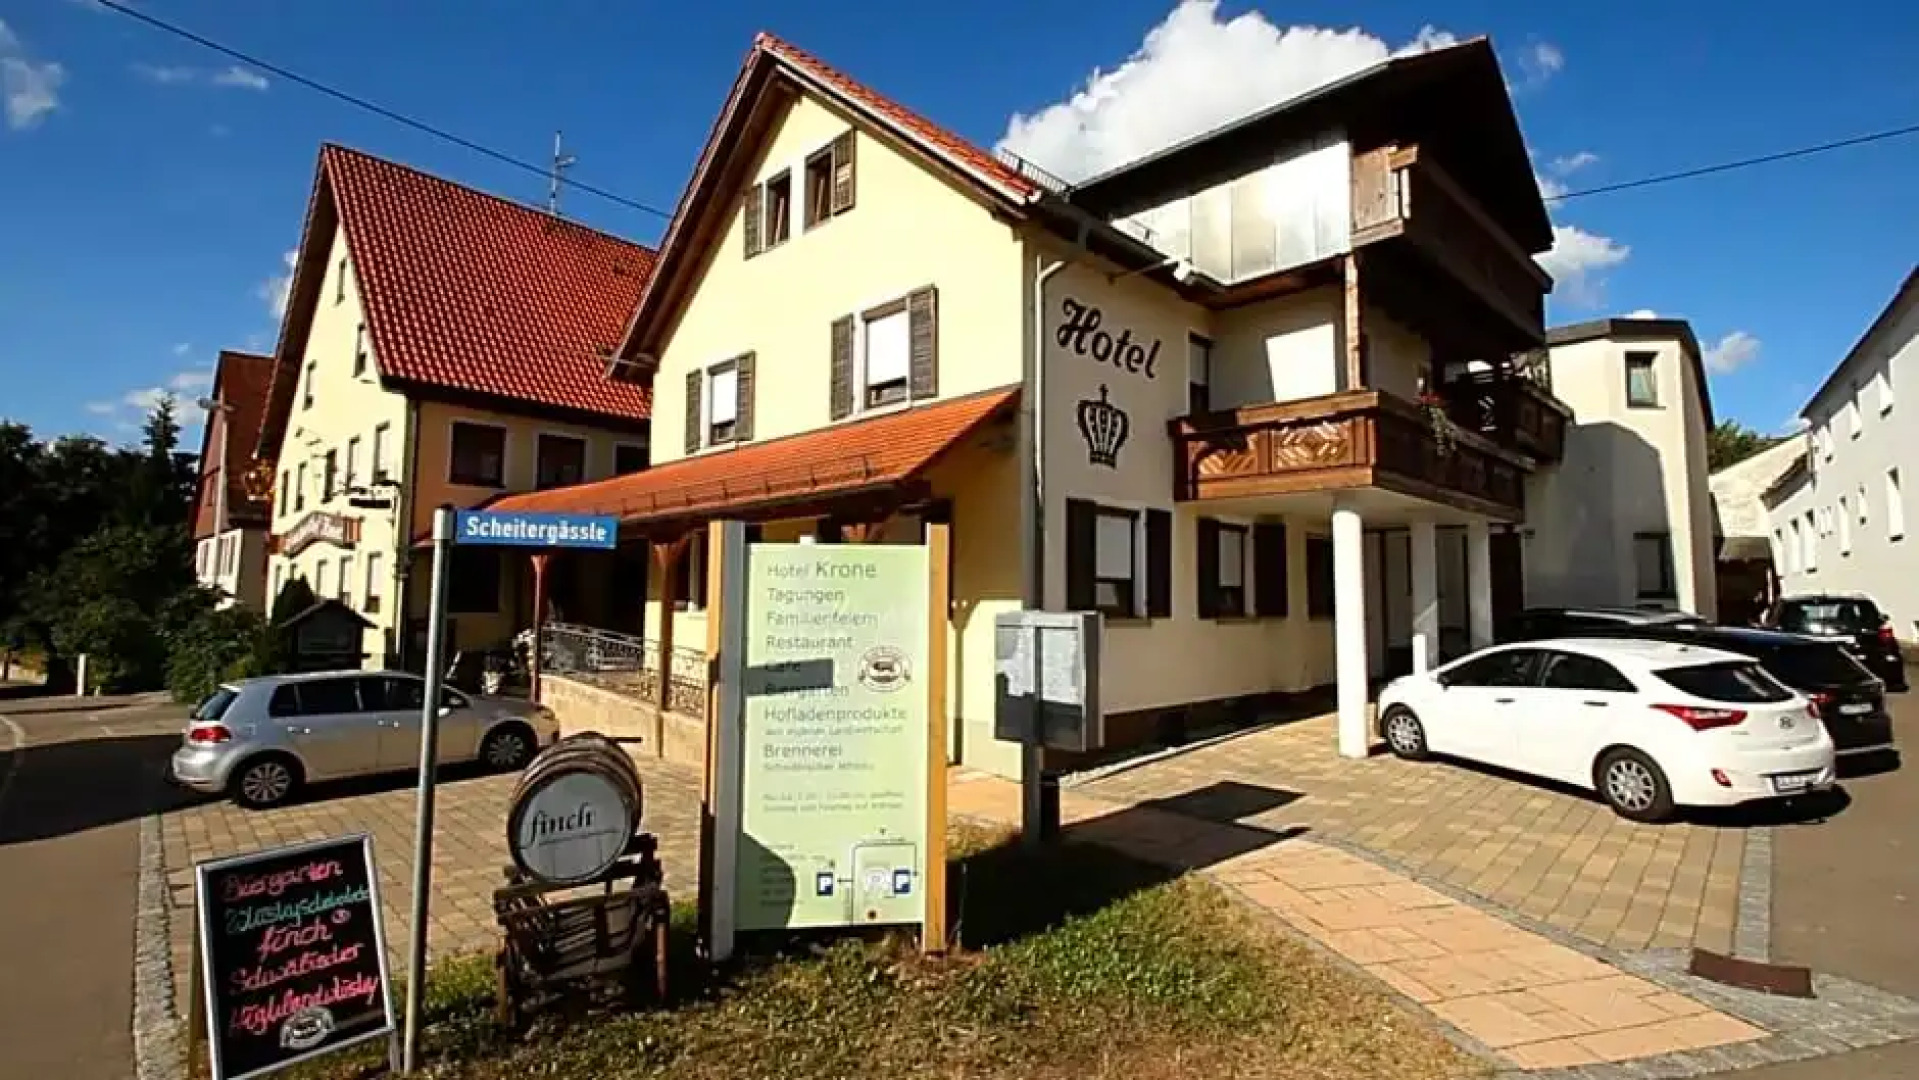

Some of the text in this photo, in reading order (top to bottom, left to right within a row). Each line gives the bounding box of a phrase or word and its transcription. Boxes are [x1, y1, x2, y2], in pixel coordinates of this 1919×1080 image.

[1056, 298, 1162, 379] Hotel
[466, 515, 607, 544] Scheitergässle
[767, 561, 877, 579] Hotel Krone
[767, 588, 844, 605] Tagungen
[766, 611, 878, 628] Familienfeiern
[766, 635, 854, 650] Restaurant
[764, 706, 908, 724] Hofladenprodukte
[763, 742, 843, 759] Brennerei
[529, 802, 597, 845] finch
